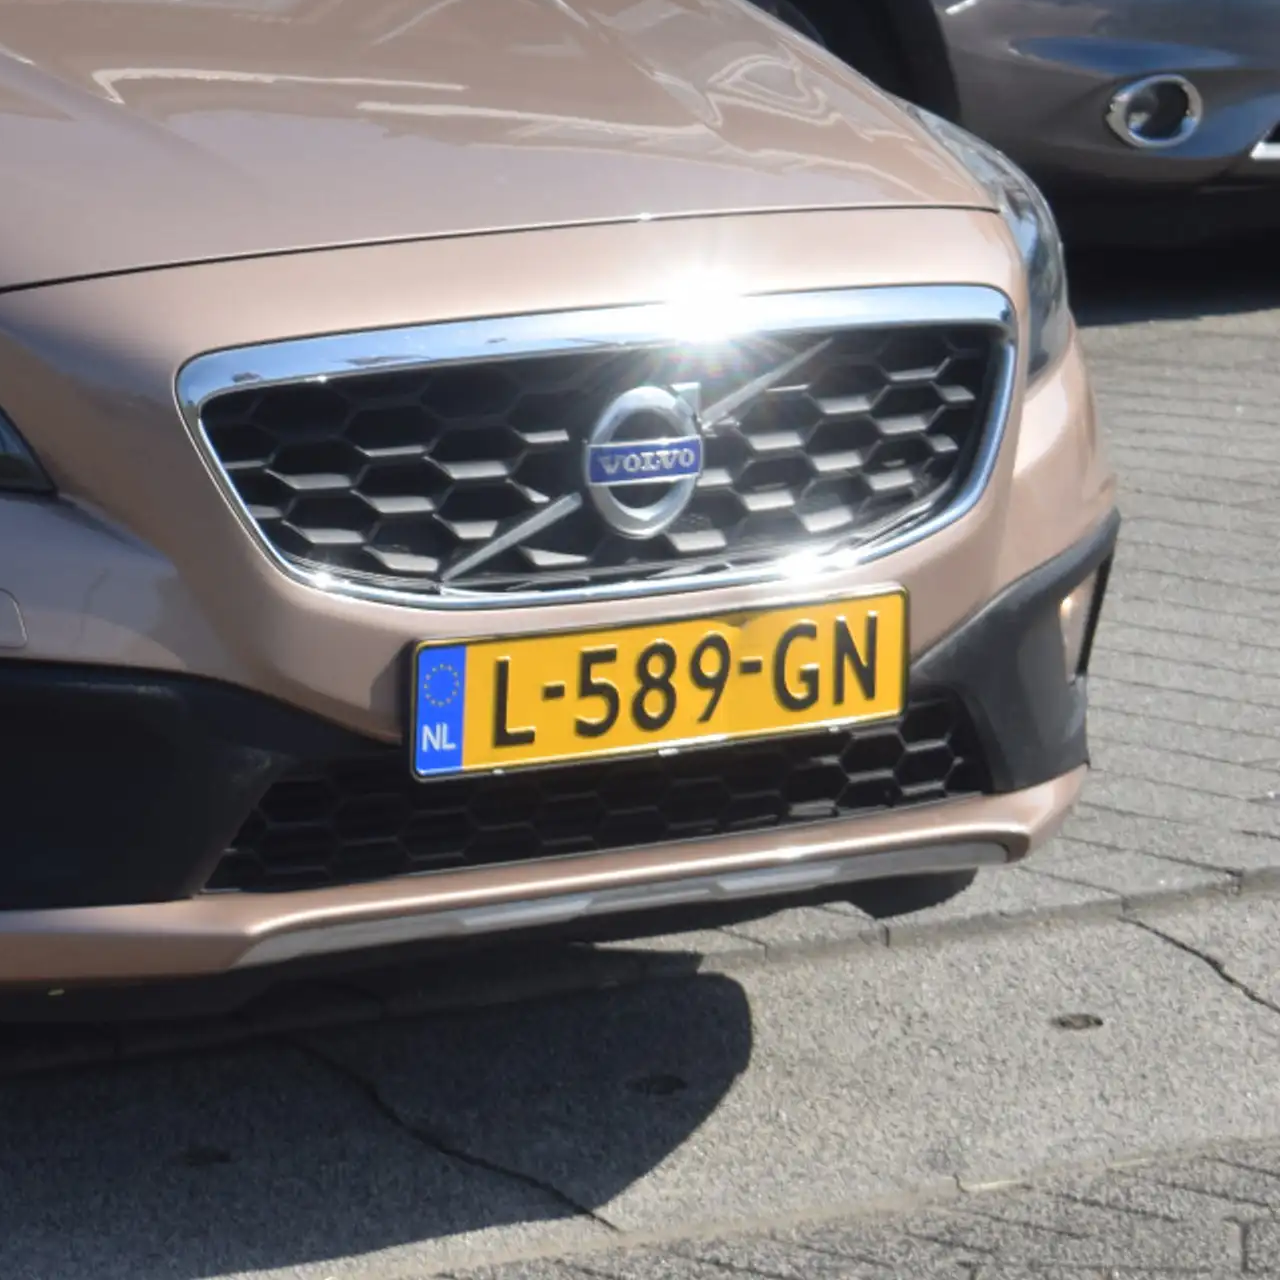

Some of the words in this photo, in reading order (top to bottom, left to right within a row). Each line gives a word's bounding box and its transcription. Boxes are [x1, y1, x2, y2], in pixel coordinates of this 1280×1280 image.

[598, 448, 695, 475] VOLVO
[492, 610, 879, 749] L-589-GN
[421, 722, 457, 752] NL
